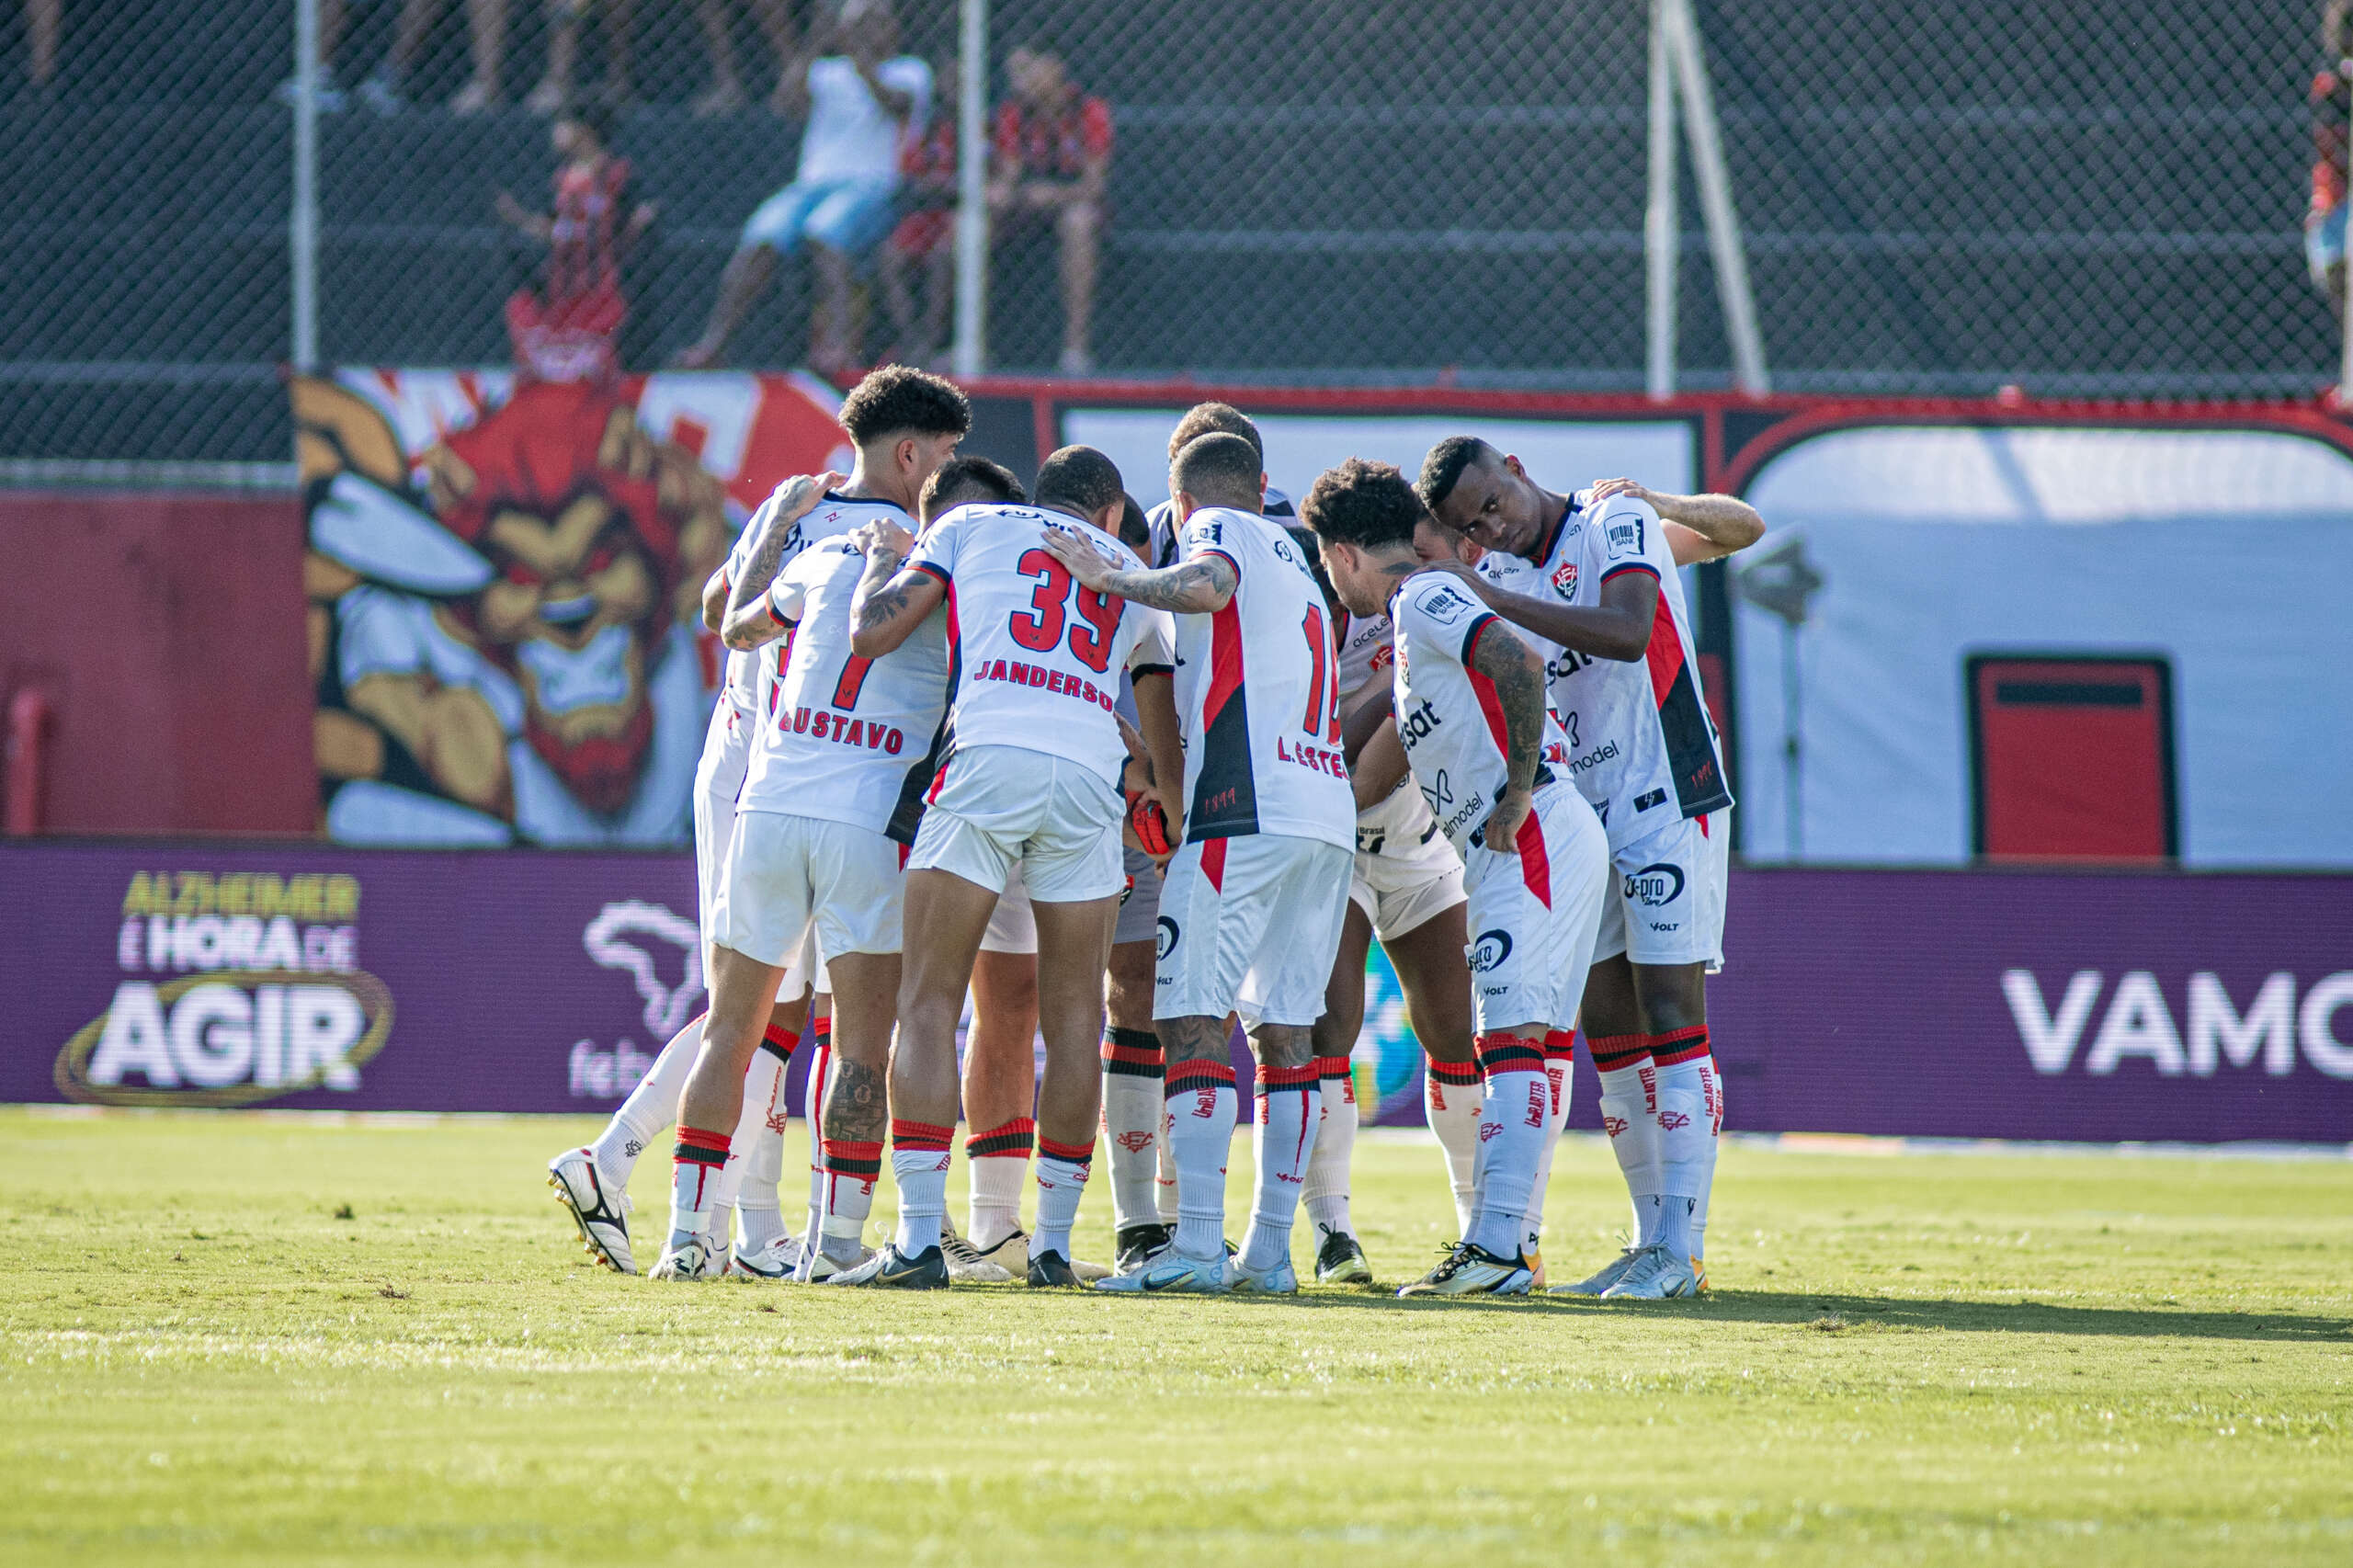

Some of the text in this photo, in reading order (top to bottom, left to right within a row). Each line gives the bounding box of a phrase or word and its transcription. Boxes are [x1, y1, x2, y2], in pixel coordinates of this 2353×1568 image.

[1008, 547, 1127, 674] 39
[1204, 787, 1236, 815] 1899
[1359, 826, 1385, 835] Brasil
[1650, 922, 1679, 933] VOLT
[147, 913, 301, 972] HORA
[304, 925, 359, 975] DE
[1483, 985, 1509, 996] VOLT
[89, 980, 365, 1088] AGIR
